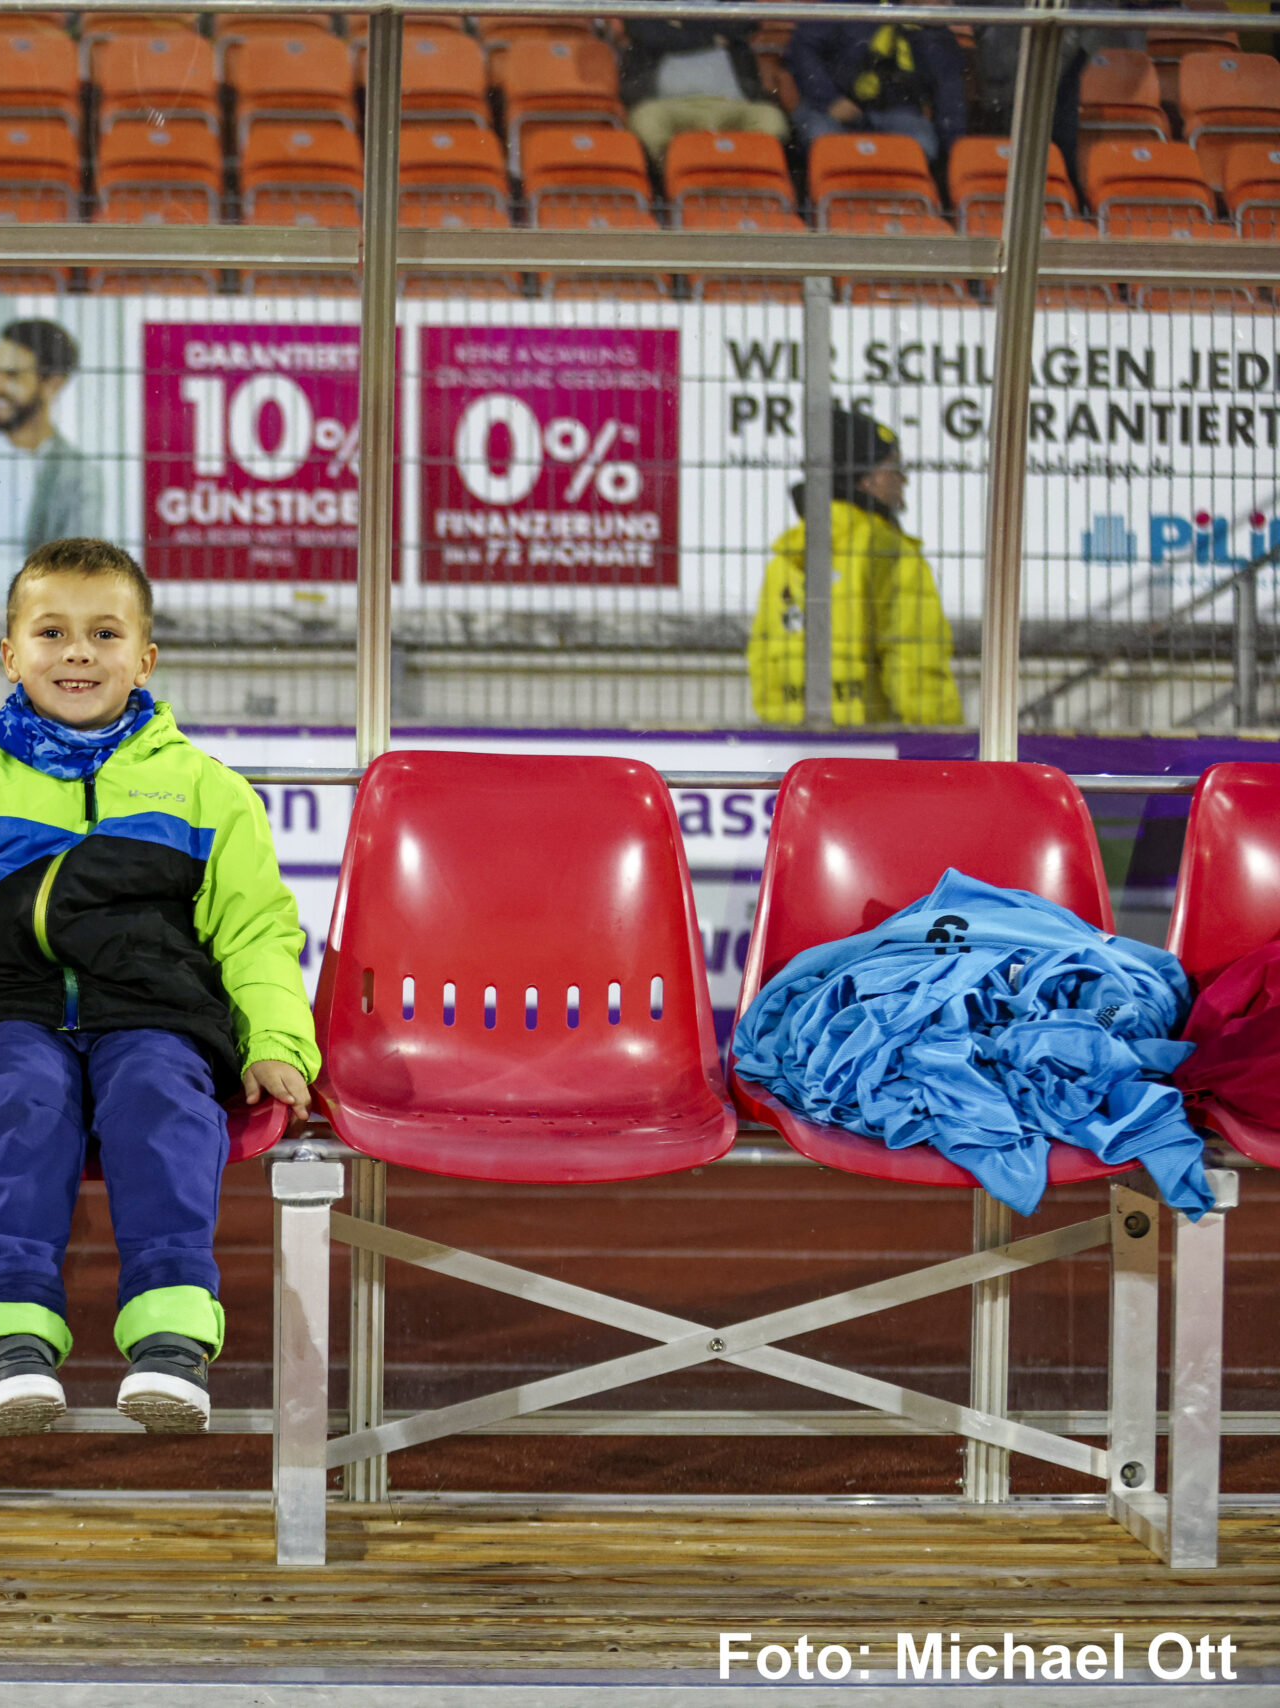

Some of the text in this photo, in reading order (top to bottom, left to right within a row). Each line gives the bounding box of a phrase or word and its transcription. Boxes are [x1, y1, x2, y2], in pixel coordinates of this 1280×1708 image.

[728, 339, 838, 382] WI
[864, 341, 1154, 389] SCHLGEN
[944, 397, 1280, 449] GRANTIERT
[156, 482, 359, 527] GÜNSTIGE
[434, 510, 661, 541] FINANZIERUNG
[1149, 508, 1280, 567] PiLi
